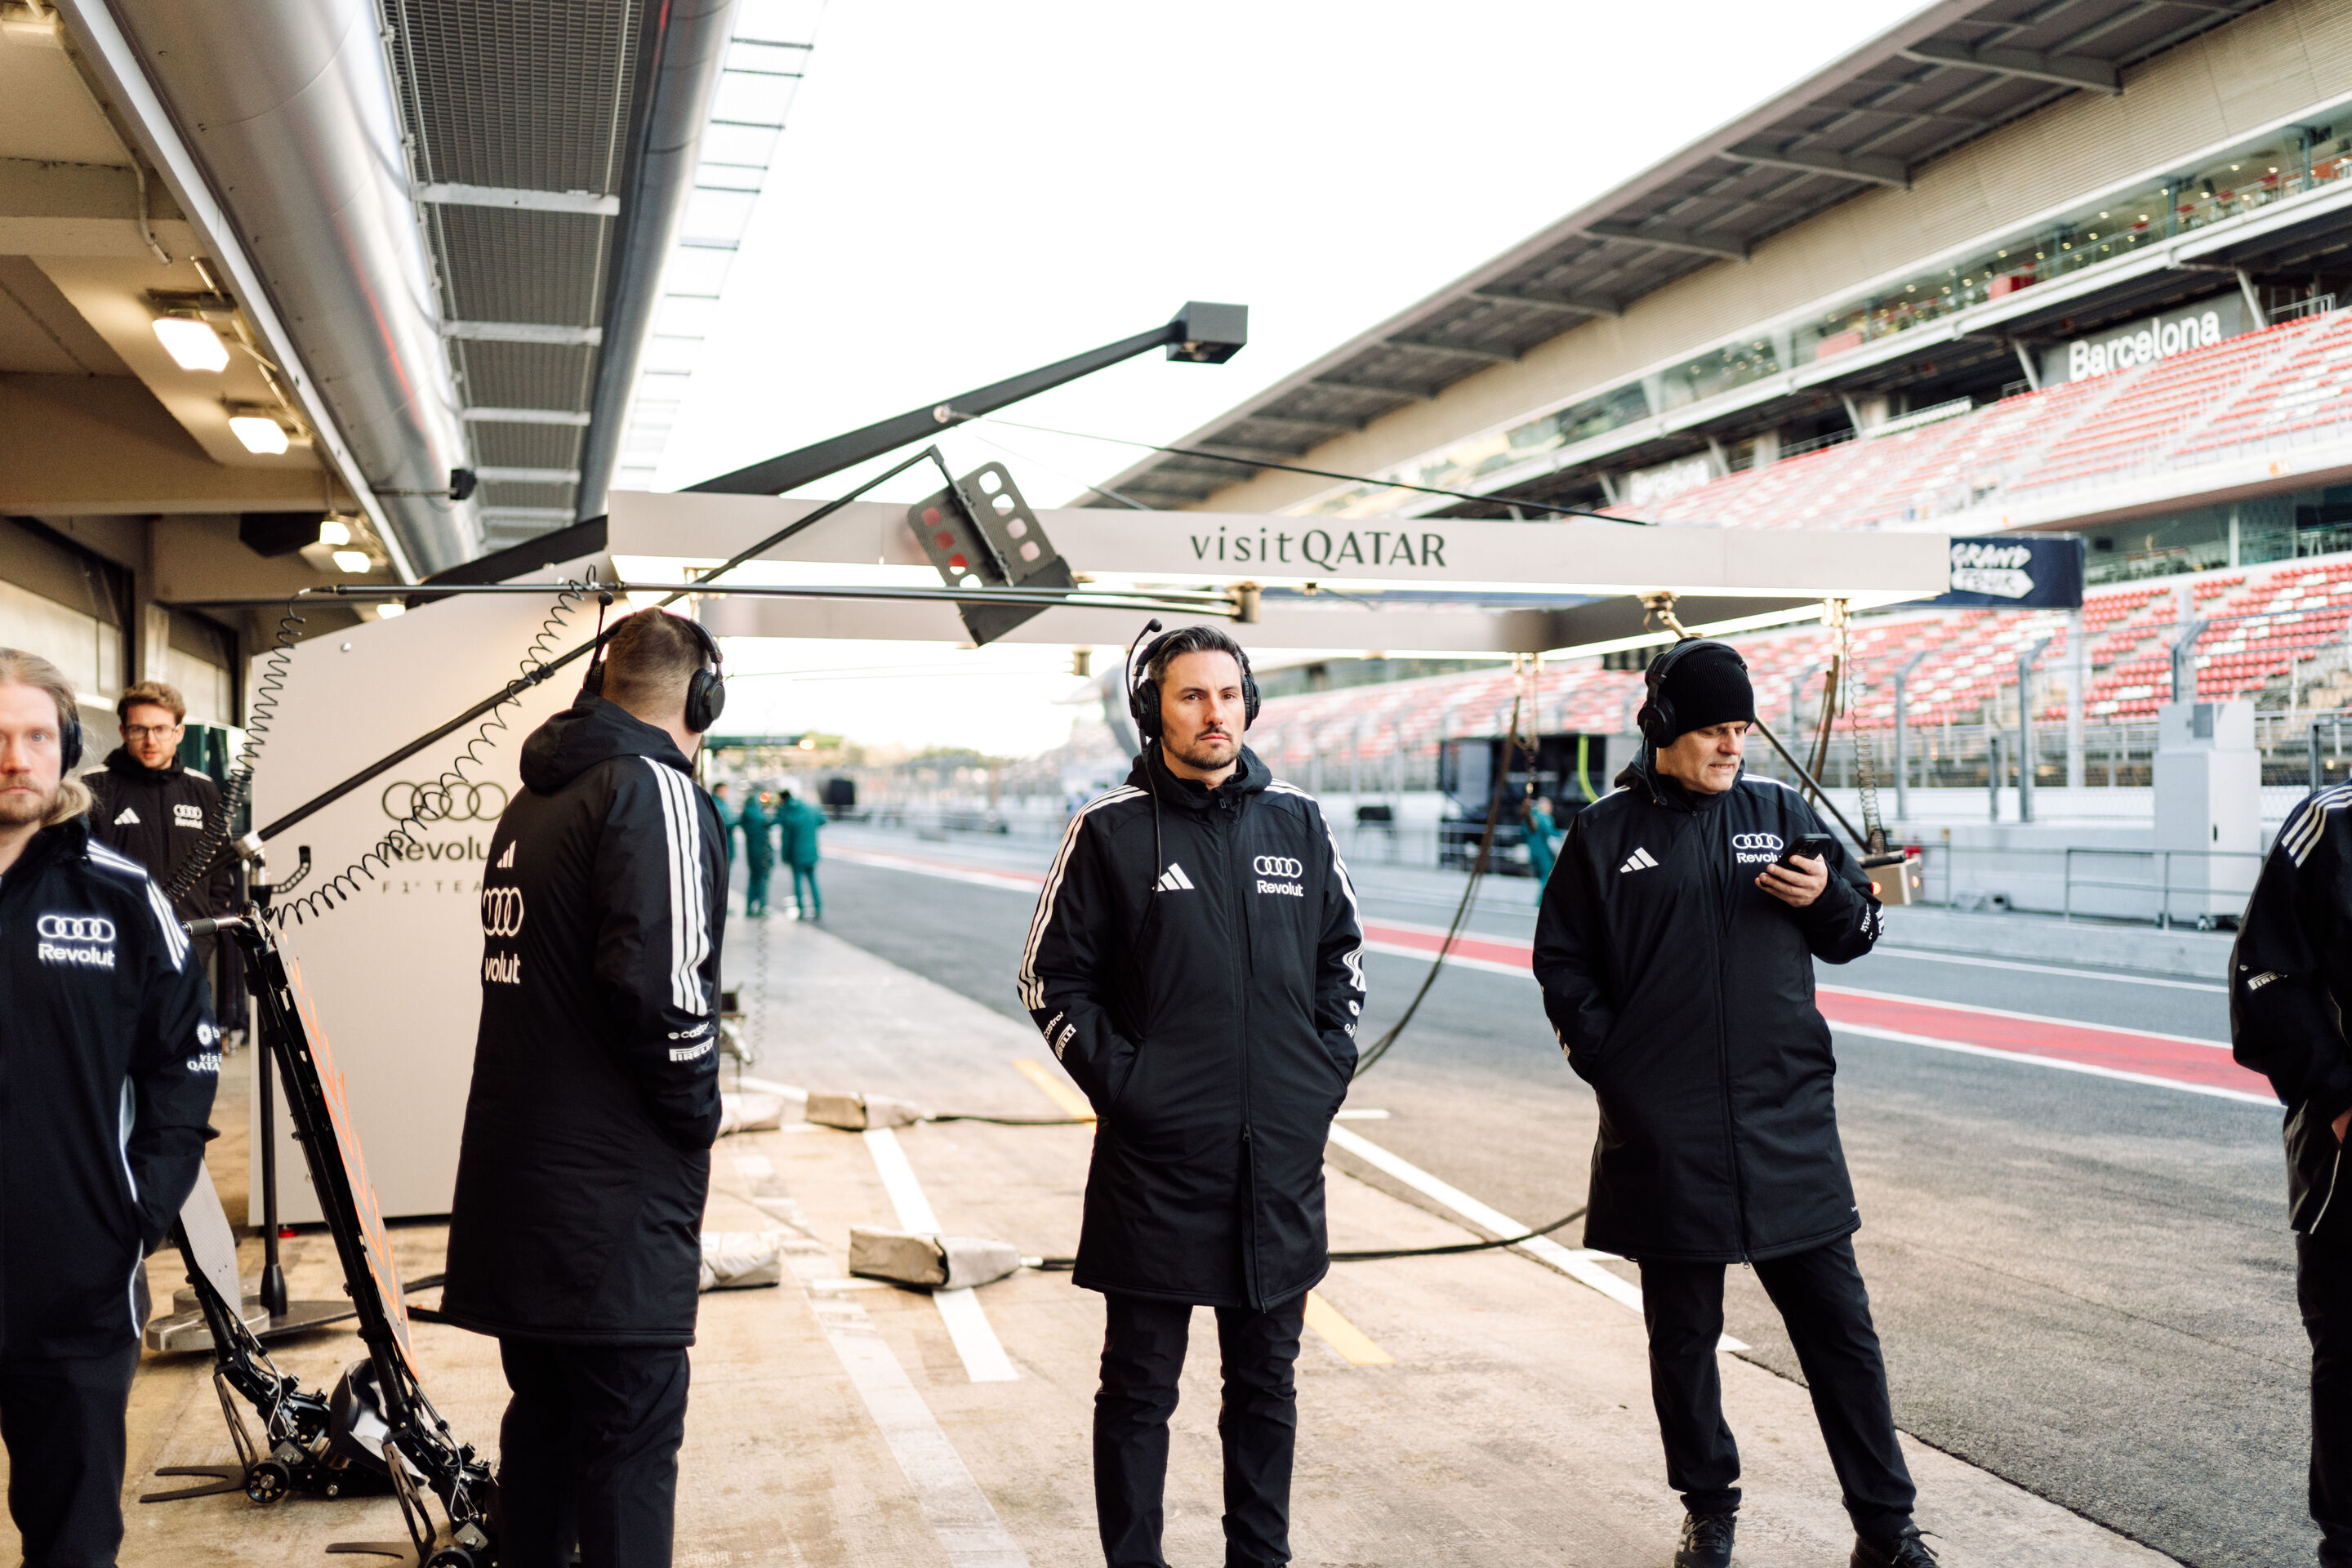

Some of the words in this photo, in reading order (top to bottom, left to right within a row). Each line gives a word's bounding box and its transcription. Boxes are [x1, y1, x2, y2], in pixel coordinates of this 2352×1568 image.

[2069, 311, 2222, 382] Barcelona
[383, 835, 492, 861] Revolu
[435, 880, 482, 893] TEA
[1257, 880, 1304, 898] Revolut
[38, 942, 116, 968] Revolut
[485, 950, 521, 984] volut
[2247, 971, 2279, 990] PIRE
[199, 1053, 222, 1063] visi
[669, 1036, 715, 1062] PIRELLI
[186, 1061, 220, 1071] QATA
